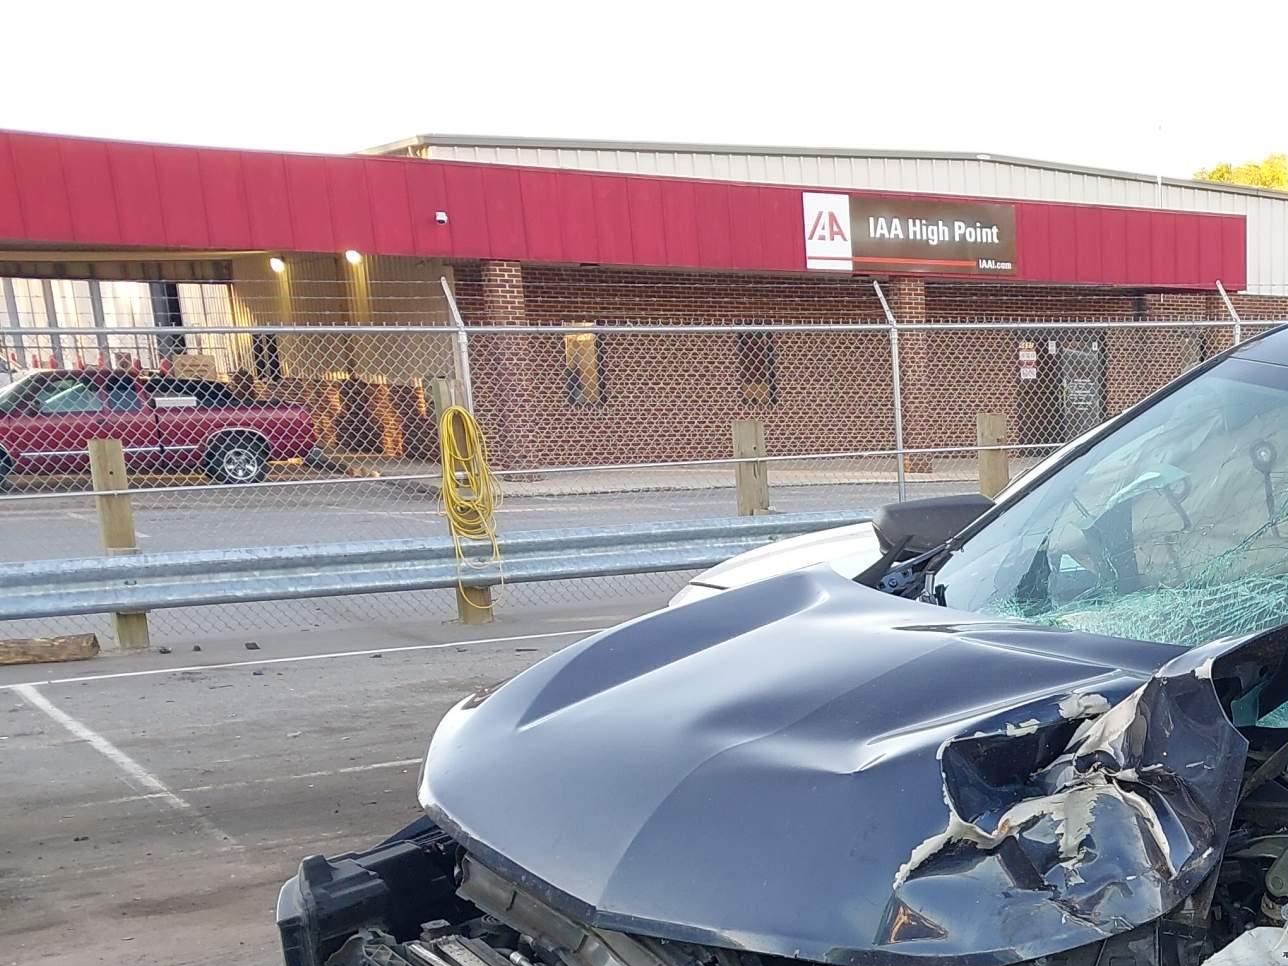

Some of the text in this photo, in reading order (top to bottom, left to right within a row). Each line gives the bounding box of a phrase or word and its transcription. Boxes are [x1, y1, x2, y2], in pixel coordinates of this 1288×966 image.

[869, 216, 1000, 246] IAA High Point
[978, 259, 1012, 270] IAAI.com
